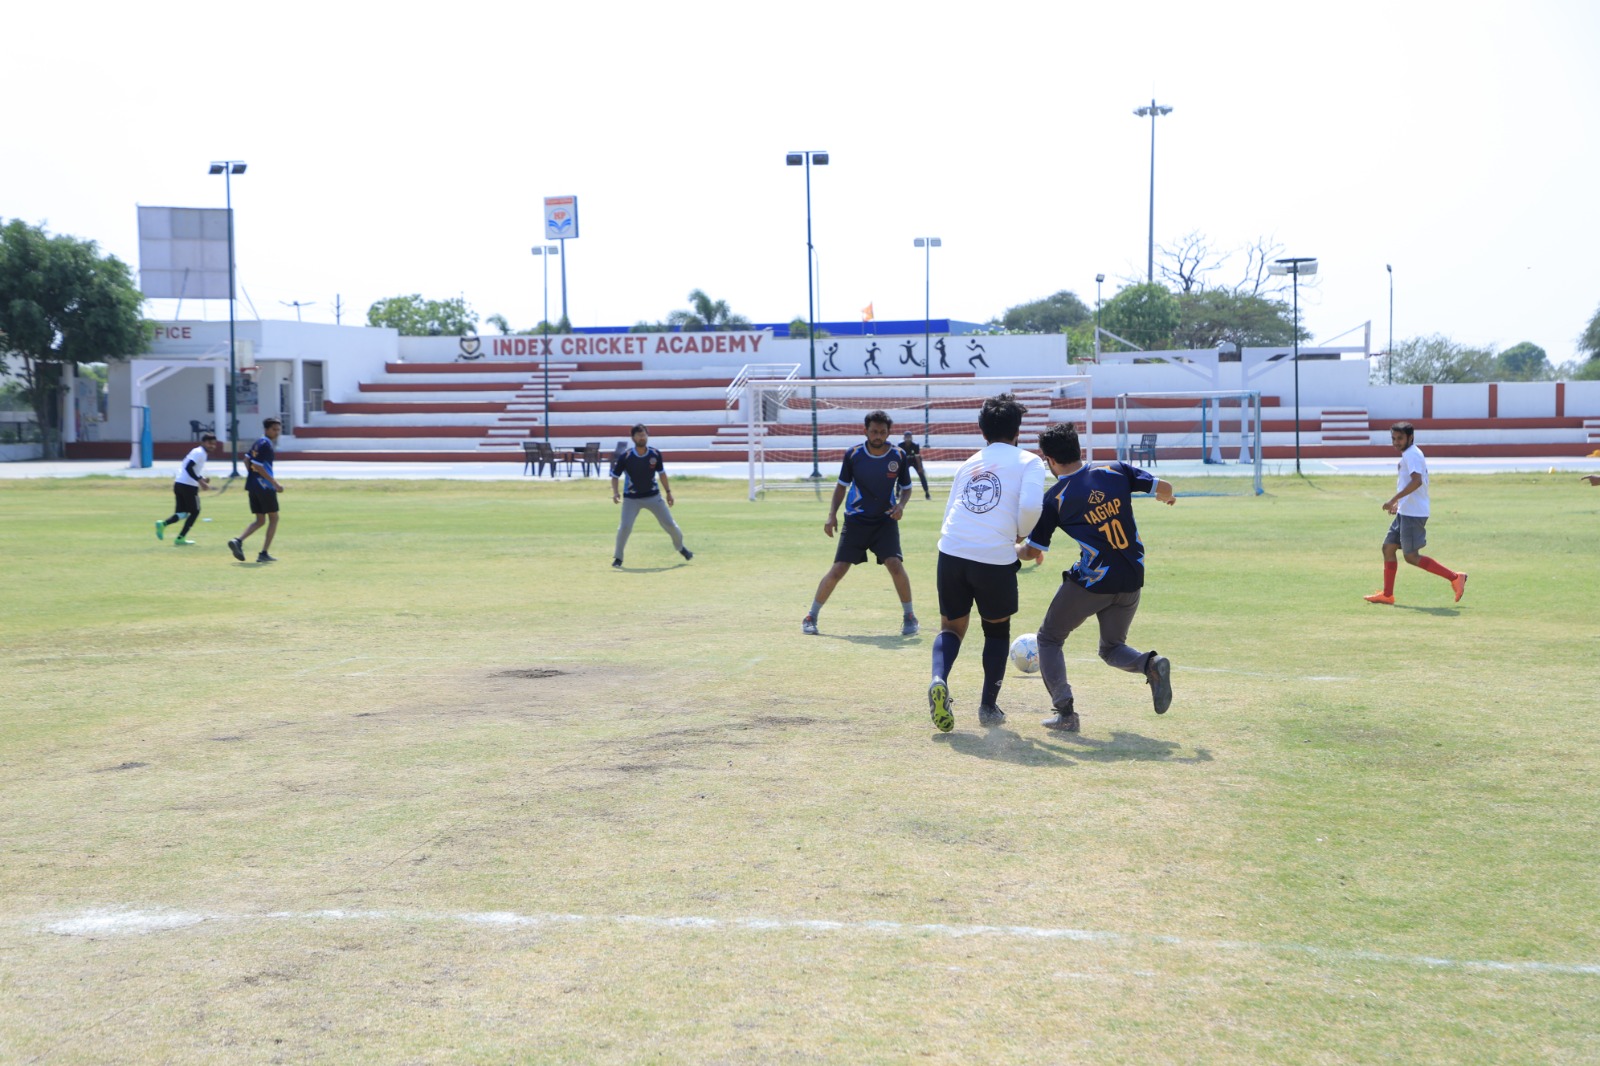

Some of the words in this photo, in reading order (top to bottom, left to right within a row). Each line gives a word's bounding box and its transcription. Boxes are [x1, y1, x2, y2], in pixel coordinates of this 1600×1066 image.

[154, 326, 192, 340] FICE
[493, 337, 554, 356] INDEX
[560, 336, 648, 355] CRICKET
[655, 334, 764, 354] ACADEMY
[1098, 518, 1129, 550] 10
